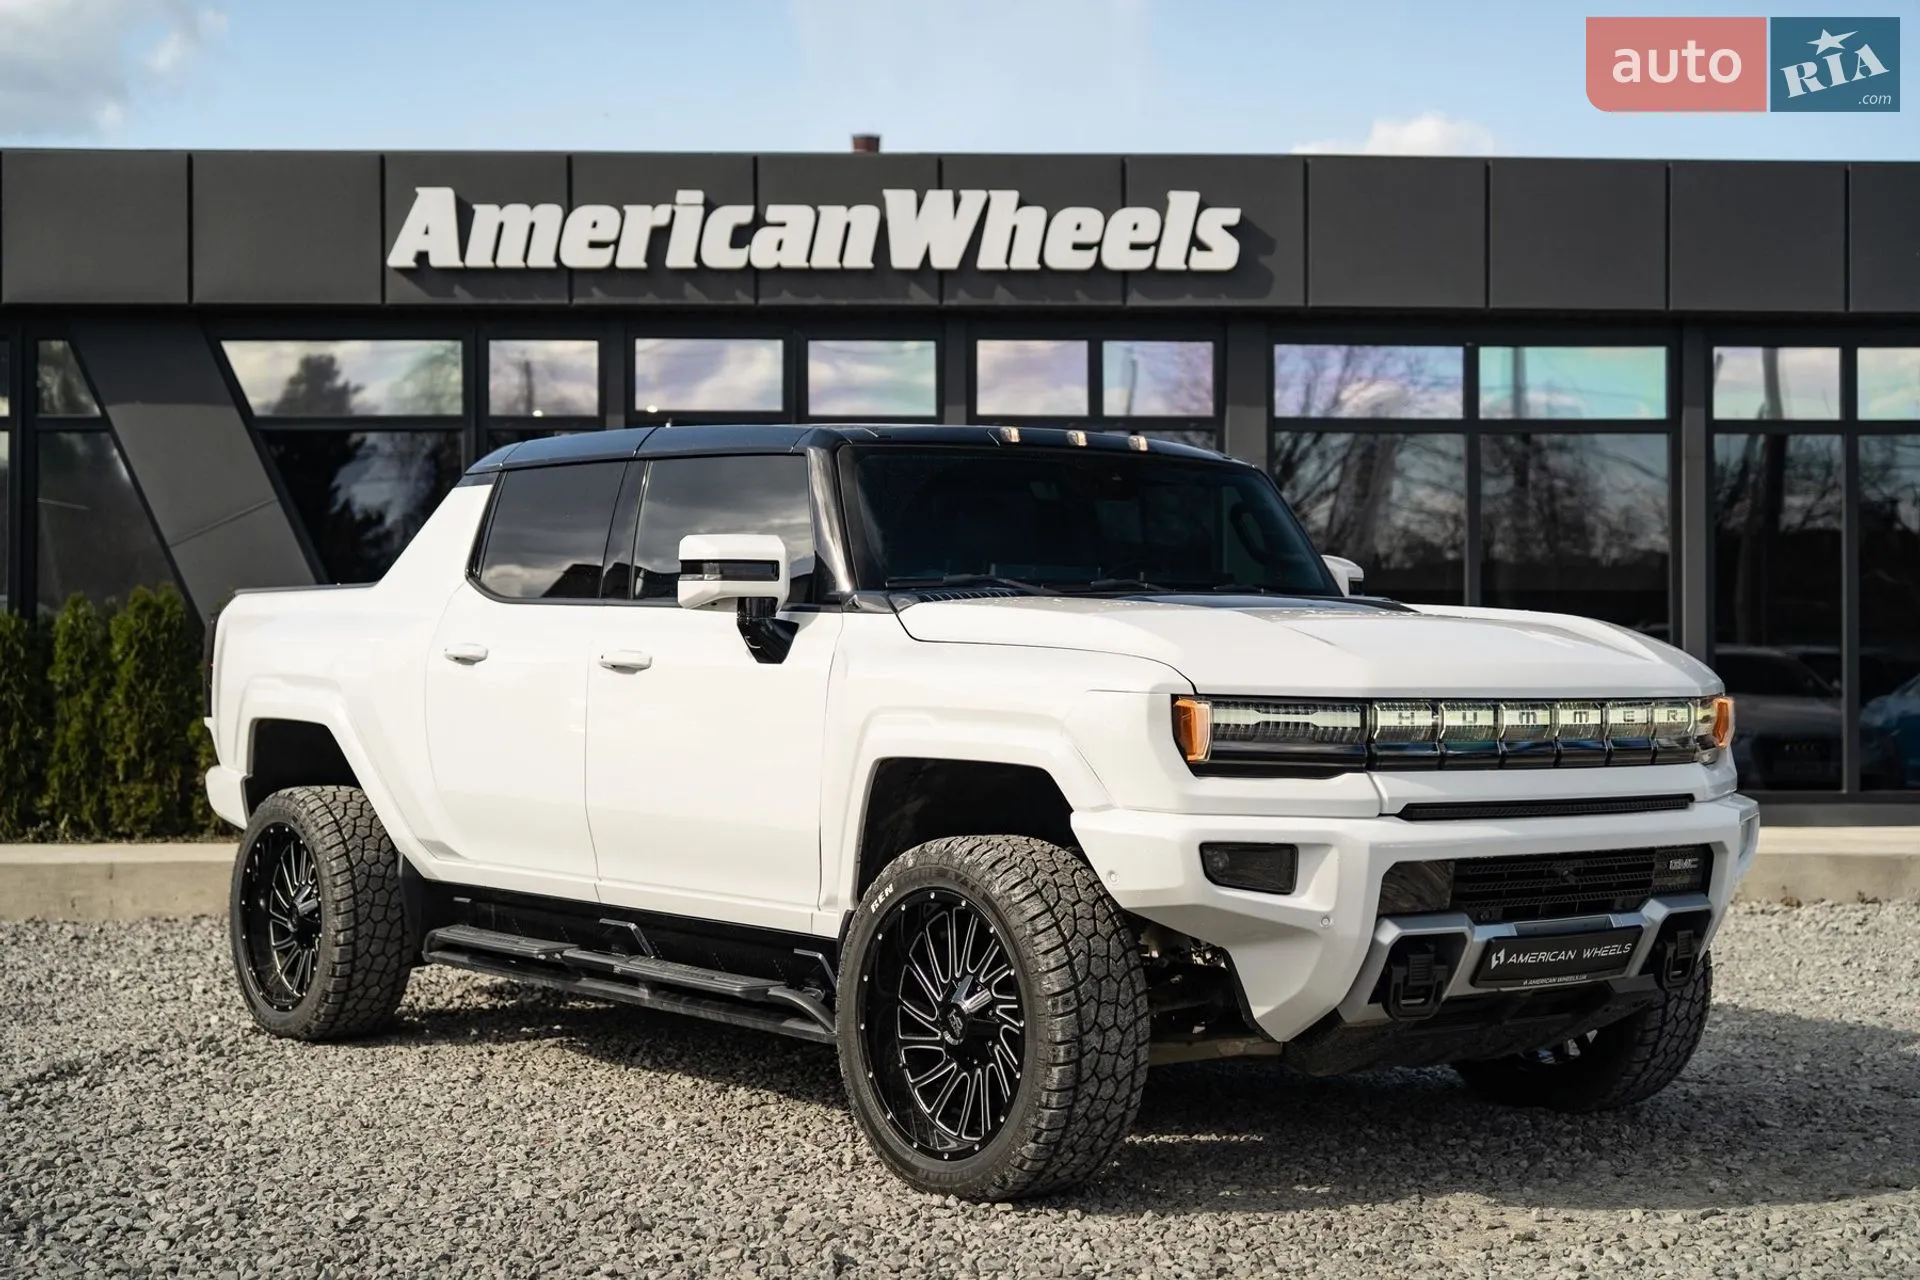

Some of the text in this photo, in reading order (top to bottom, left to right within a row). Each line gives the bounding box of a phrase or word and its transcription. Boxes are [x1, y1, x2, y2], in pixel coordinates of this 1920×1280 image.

[387, 187, 1242, 271] AmericanWheels
[1398, 710, 1680, 726] HUMMER
[1507, 943, 1632, 964] AMERICAN WHEELS
